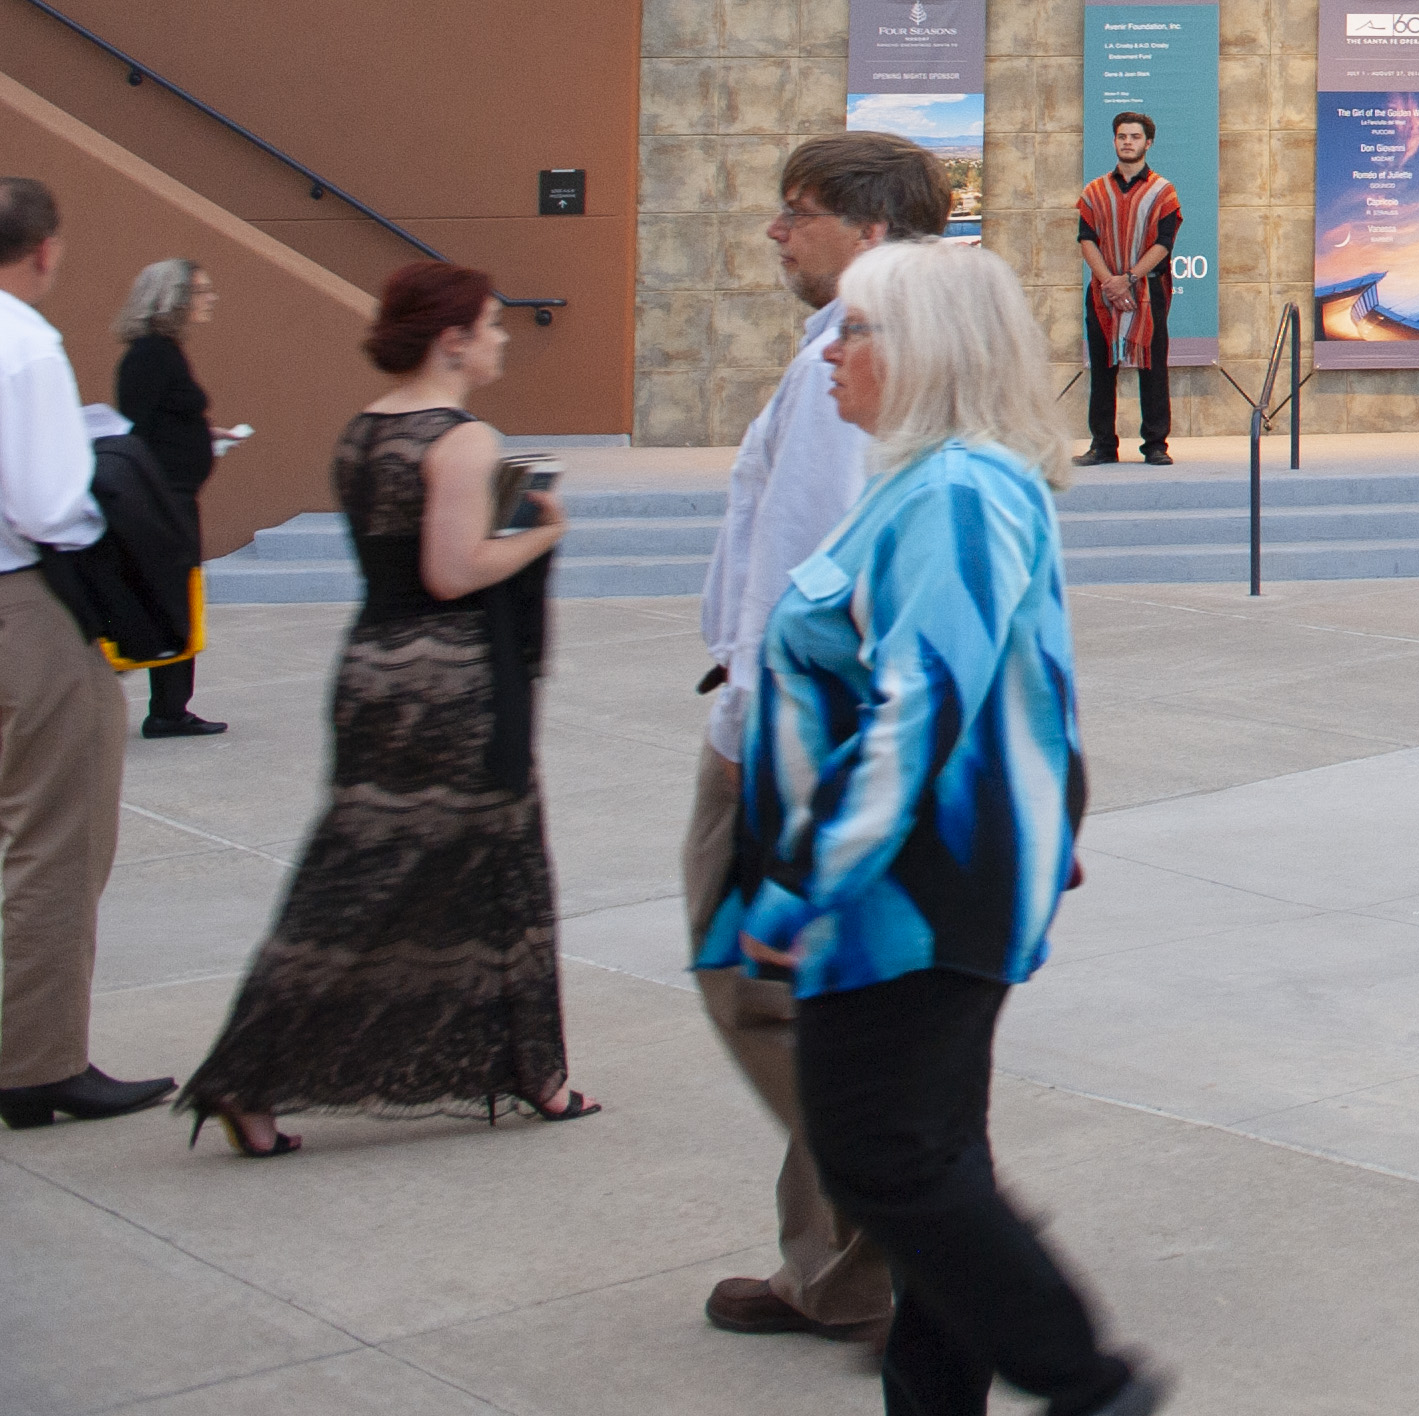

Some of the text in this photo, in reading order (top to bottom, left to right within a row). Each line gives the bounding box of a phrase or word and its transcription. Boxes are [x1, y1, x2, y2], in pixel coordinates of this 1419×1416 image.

[878, 27, 958, 35] FOUR SEASONS
[1337, 108, 1351, 117] The
[1352, 108, 1365, 117] Girl
[1365, 108, 1373, 117] of
[1374, 108, 1386, 117] the
[1387, 108, 1412, 117] Golden
[1360, 143, 1406, 152] Don Giovanni
[1387, 170, 1413, 179] Juliette
[1366, 197, 1399, 207] Capriccio
[1367, 224, 1397, 233] Vanessa
[1170, 255, 1208, 279] CIO
